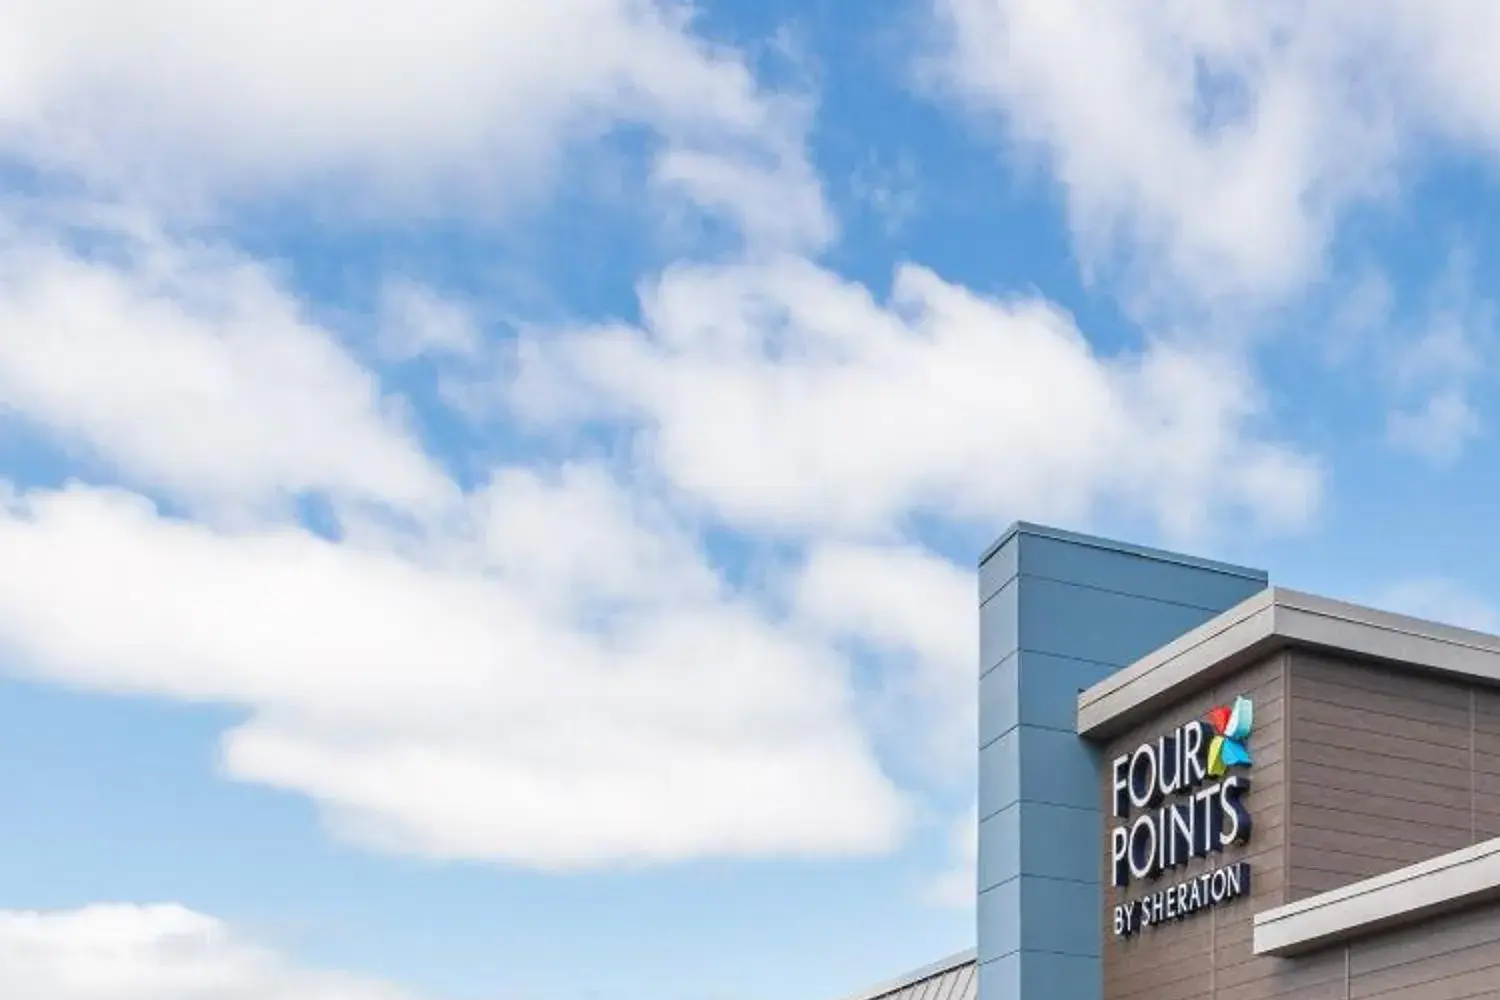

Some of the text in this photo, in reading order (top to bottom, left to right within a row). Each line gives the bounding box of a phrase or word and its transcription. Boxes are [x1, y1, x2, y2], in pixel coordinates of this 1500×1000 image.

[1112, 719, 1207, 817] FOUR
[1112, 775, 1241, 887] POINTS
[1113, 862, 1243, 936] BY SHERATON
